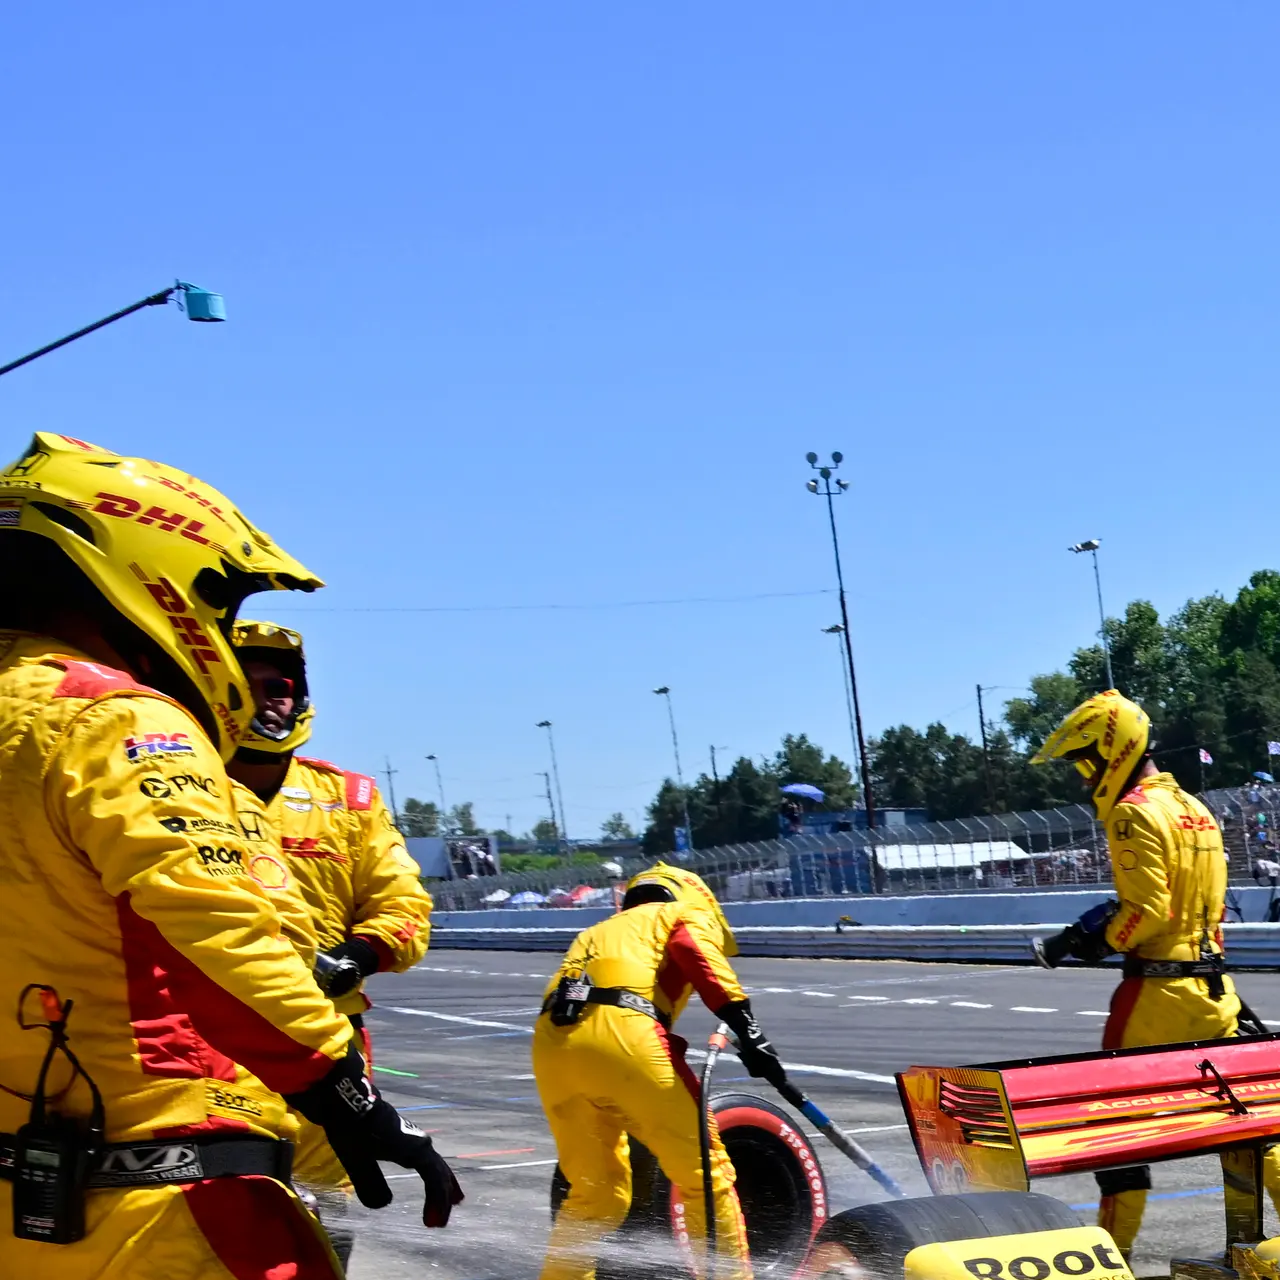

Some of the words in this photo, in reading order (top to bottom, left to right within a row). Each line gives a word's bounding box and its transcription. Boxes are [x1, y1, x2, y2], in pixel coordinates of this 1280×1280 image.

[92, 491, 211, 546] DHL
[144, 576, 222, 675] DHL
[124, 733, 192, 760] HRC
[171, 774, 221, 798] PNC
[161, 1164, 200, 1179] WEAR
[779, 1123, 826, 1218] Firestone
